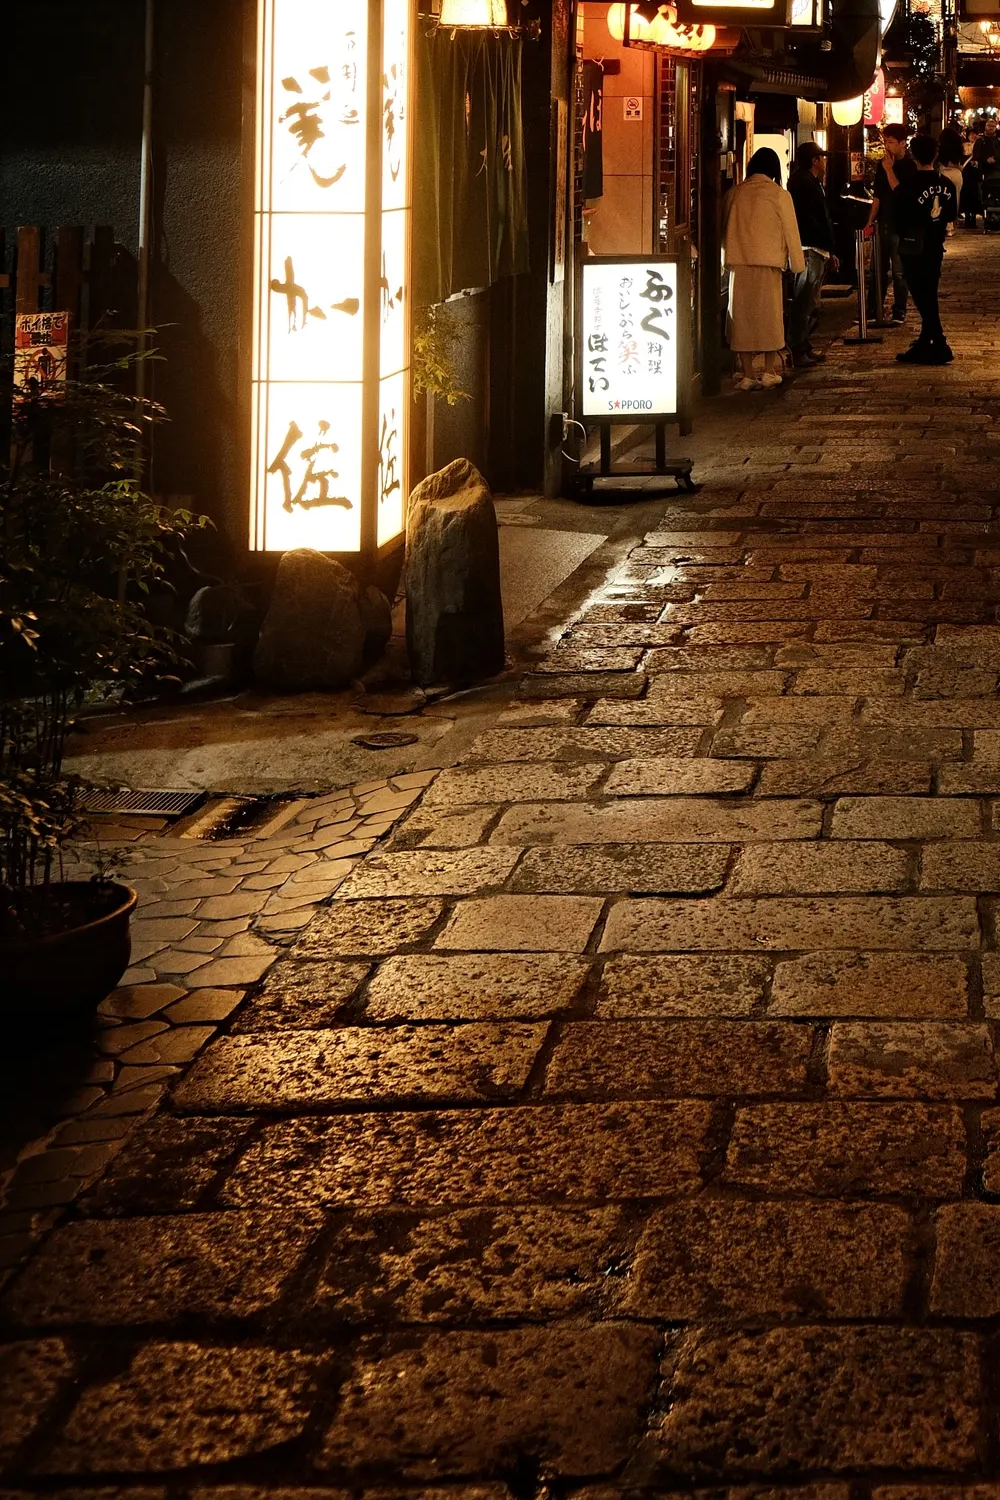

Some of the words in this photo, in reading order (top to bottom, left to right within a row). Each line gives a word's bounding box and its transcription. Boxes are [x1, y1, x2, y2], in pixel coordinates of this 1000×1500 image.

[588, 332, 610, 393] ほてい
[639, 269, 673, 375] ふぐ料理
